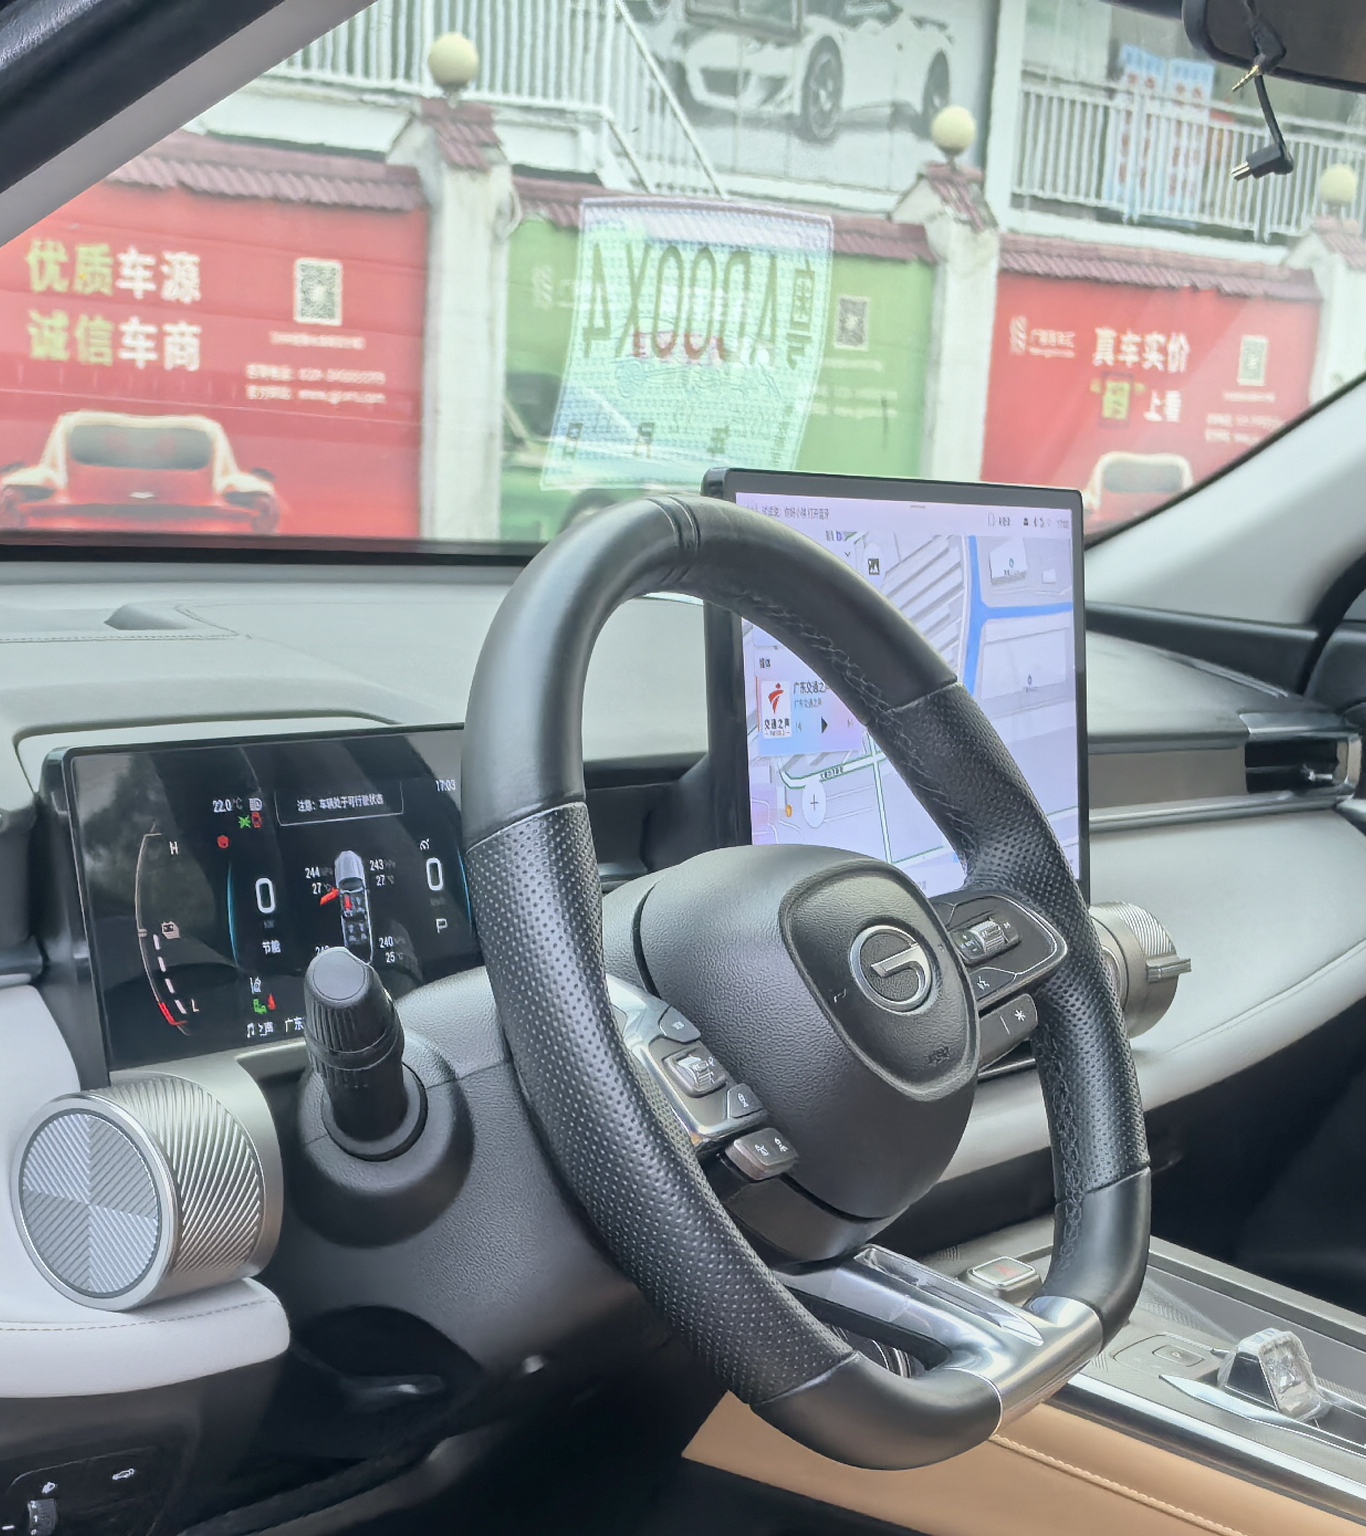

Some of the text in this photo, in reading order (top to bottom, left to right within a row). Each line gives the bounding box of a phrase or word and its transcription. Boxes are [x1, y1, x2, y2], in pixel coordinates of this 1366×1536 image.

[25, 238, 201, 304] 优质车源
[27, 308, 201, 372] 诚信车商
[1092, 326, 1191, 373] 真车实价
[169, 841, 179, 855] H
[370, 859, 384, 871] 243
[305, 867, 320, 879] 244
[426, 857, 443, 891] 0
[255, 878, 276, 914] 0
[436, 918, 448, 933] P
[262, 940, 281, 954] 节能
[379, 936, 394, 948] 240
[191, 999, 199, 1012] L
